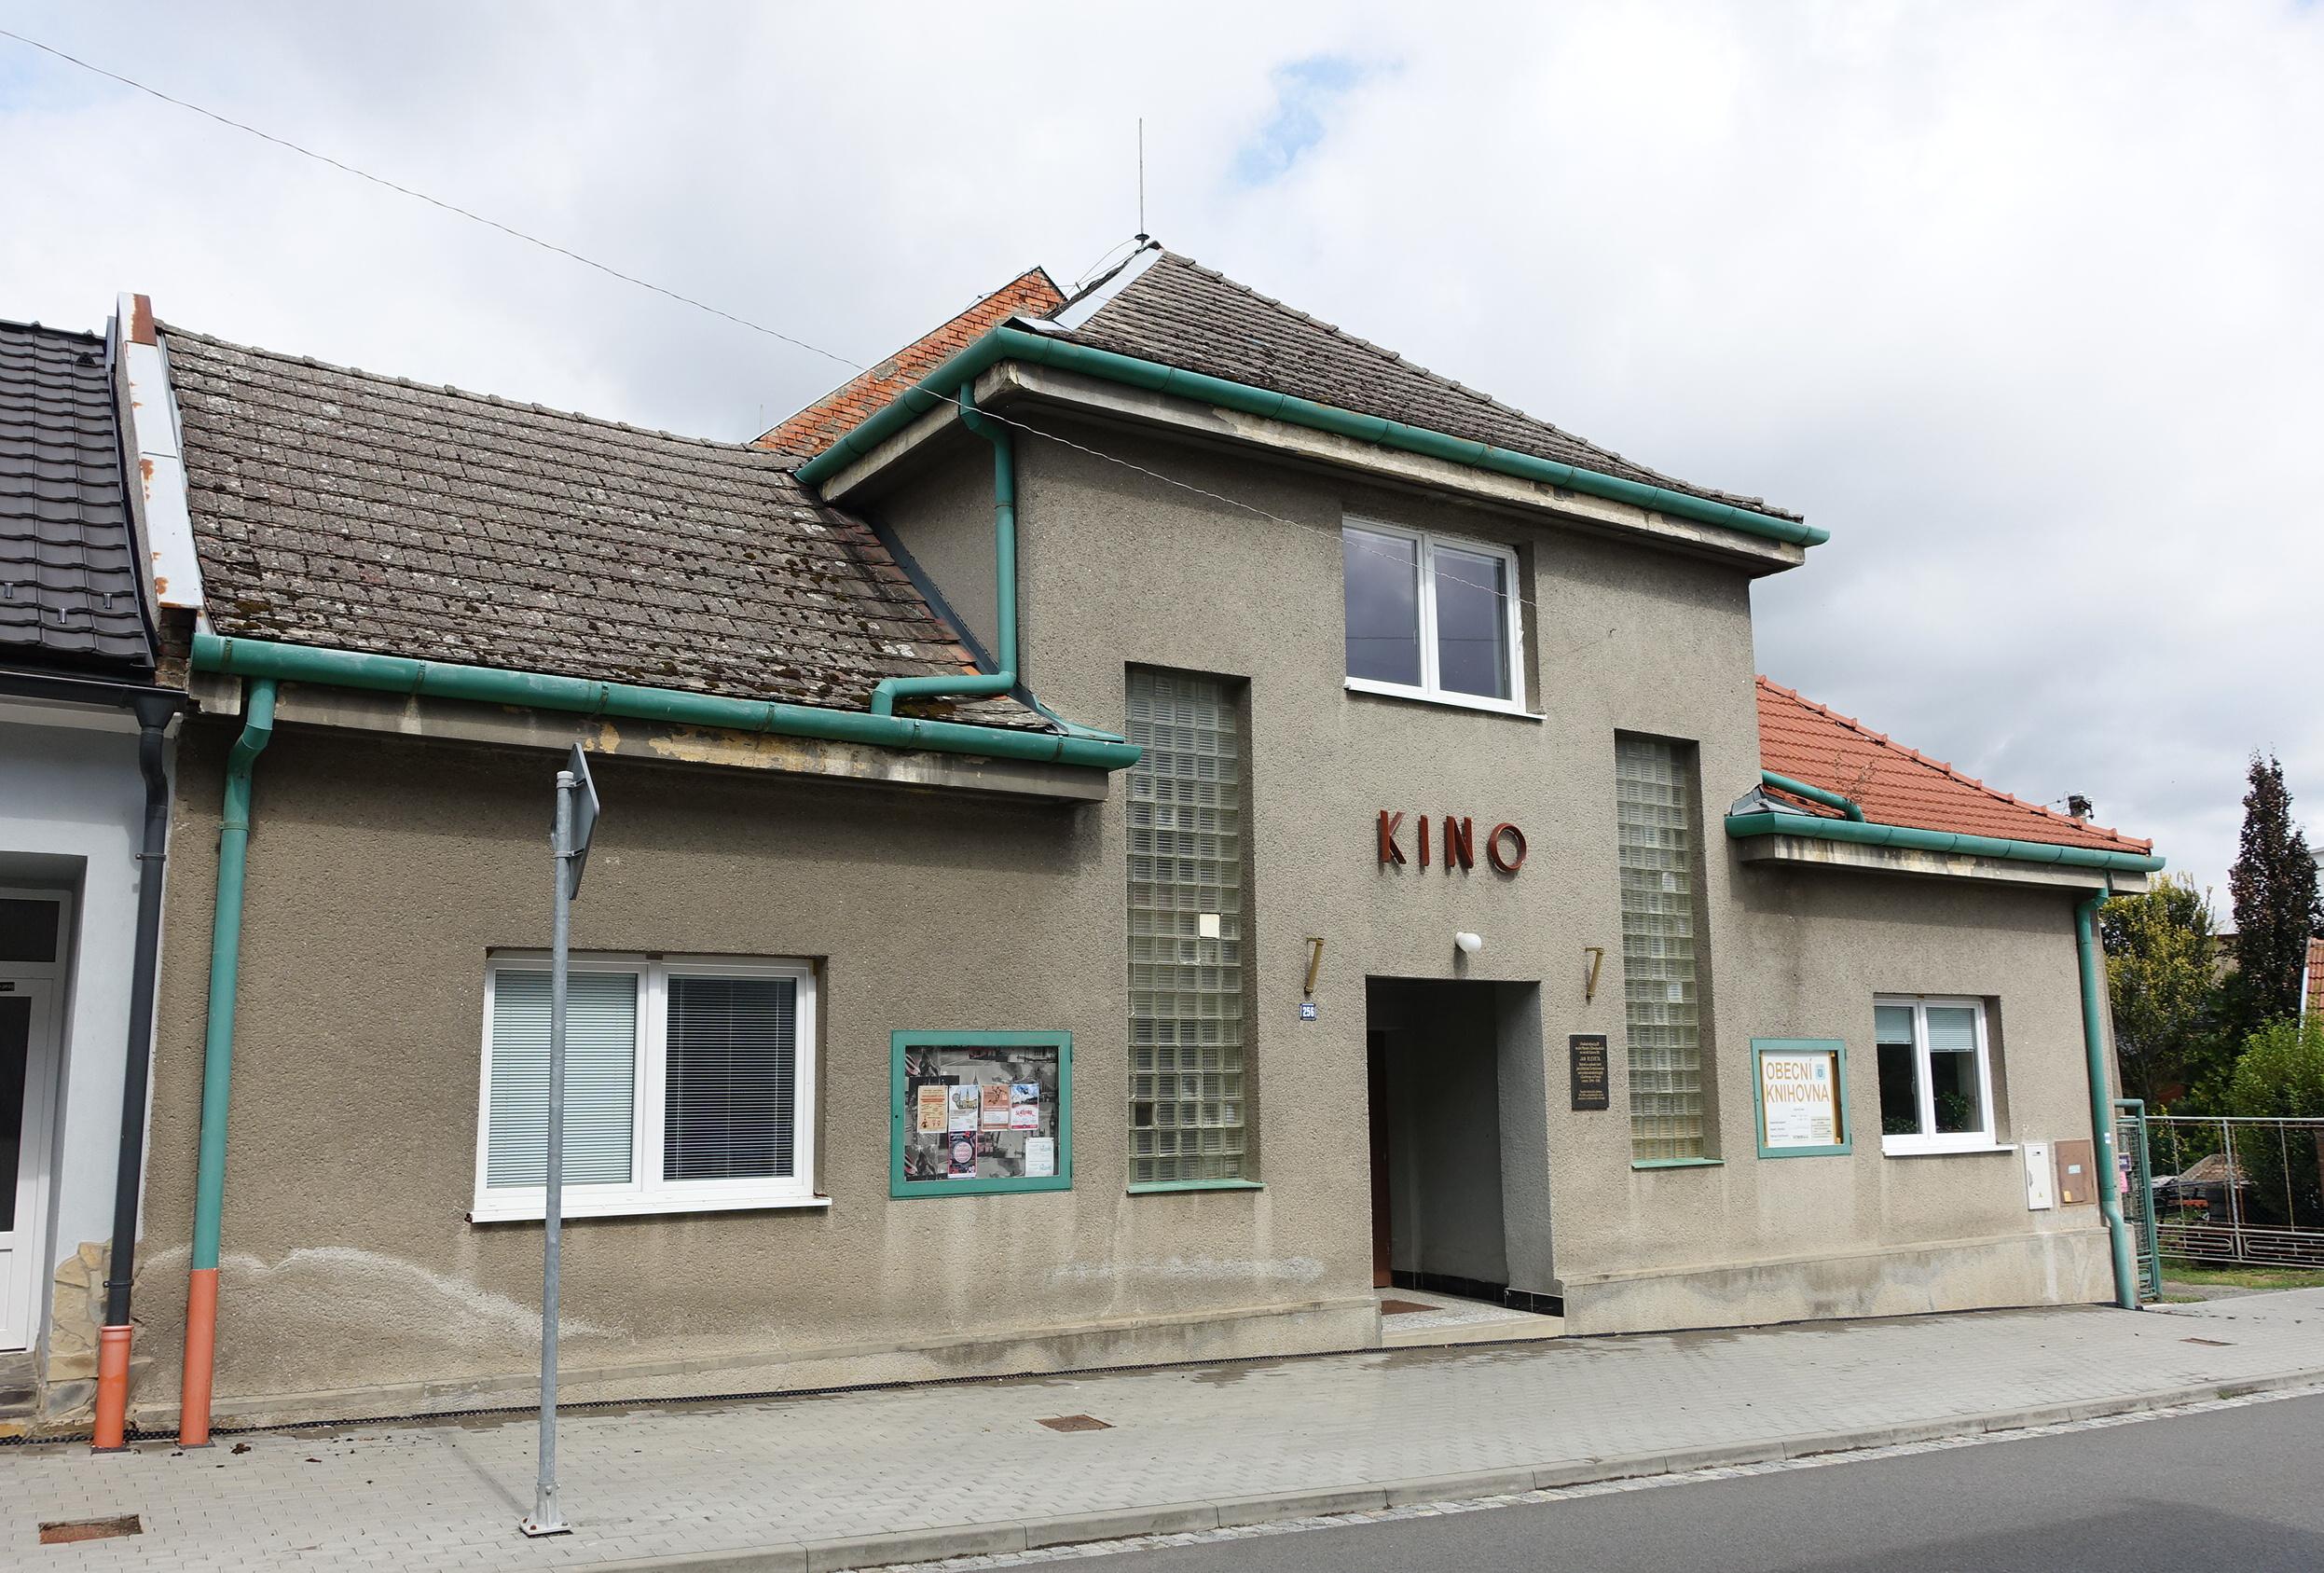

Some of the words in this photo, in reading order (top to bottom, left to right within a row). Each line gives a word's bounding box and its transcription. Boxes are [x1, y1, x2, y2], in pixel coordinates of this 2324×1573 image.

[1379, 809, 1527, 873] KINO
[1302, 1006, 1314, 1017] 256
[1766, 1057, 1812, 1080] OBECNÍ
[1766, 1083, 1829, 1103] KNIHOVNA
